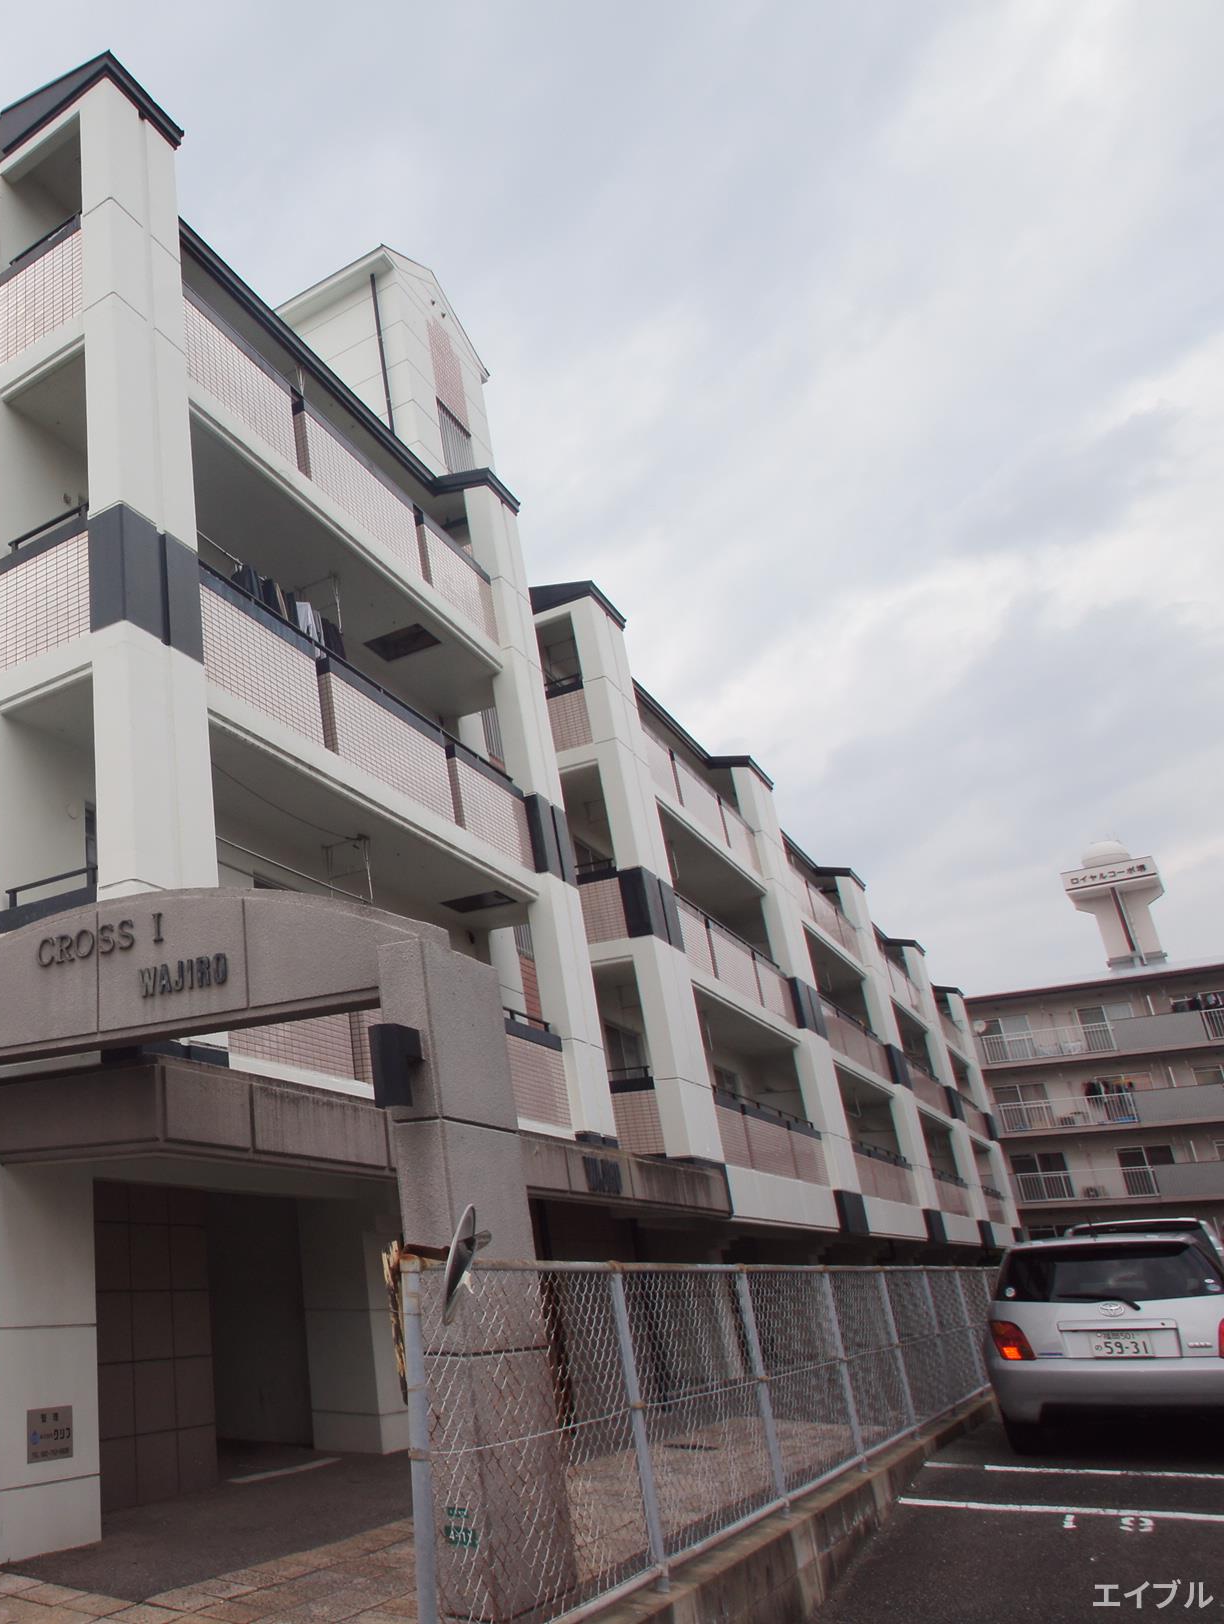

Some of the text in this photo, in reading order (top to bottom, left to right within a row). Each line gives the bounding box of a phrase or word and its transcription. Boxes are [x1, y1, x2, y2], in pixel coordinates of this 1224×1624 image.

[37, 912, 164, 968] CROSS I
[140, 952, 228, 999] WAJIRO
[1104, 1340, 1149, 1355] 59-31
